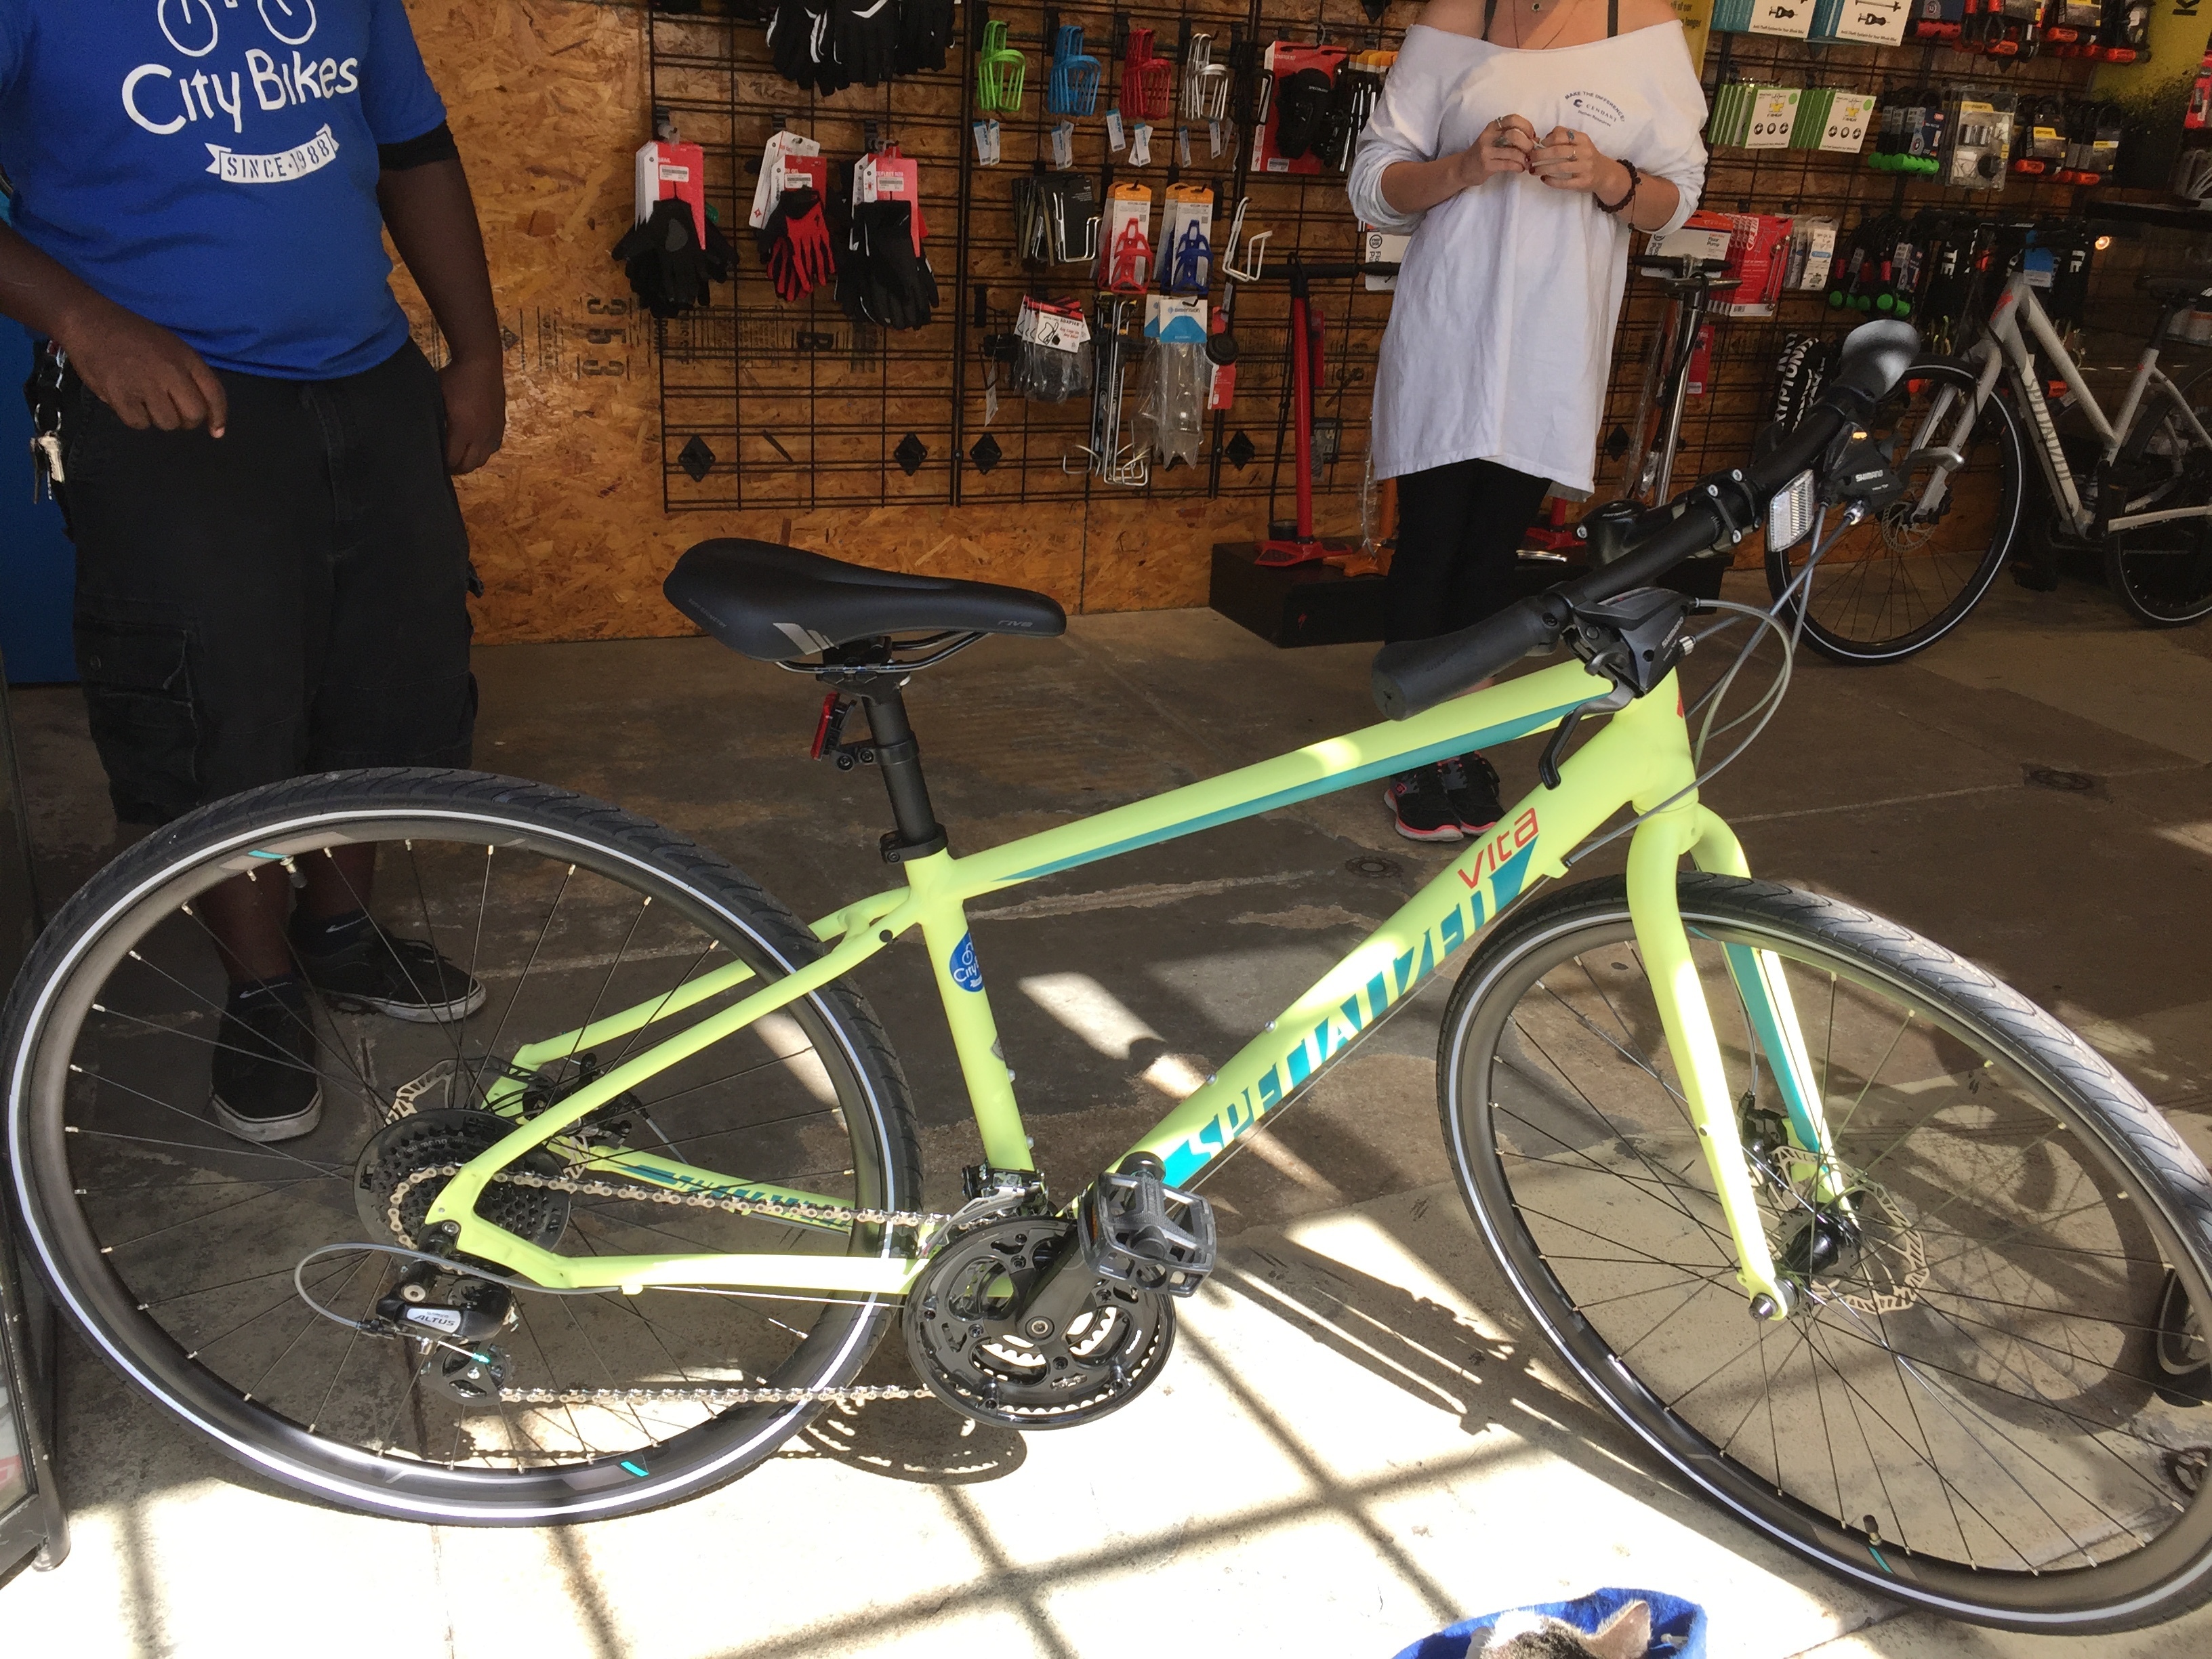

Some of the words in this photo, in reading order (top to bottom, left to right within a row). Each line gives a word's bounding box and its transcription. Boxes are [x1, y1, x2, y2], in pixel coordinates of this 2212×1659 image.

[122, 64, 242, 134] City
[245, 48, 359, 110] Bikes
[1565, 91, 1581, 100] MAKE
[1855, 469, 1883, 483] SHIMANO
[1661, 616, 1684, 649] SHIMANO
[413, 1315, 455, 1326] ALTUS
